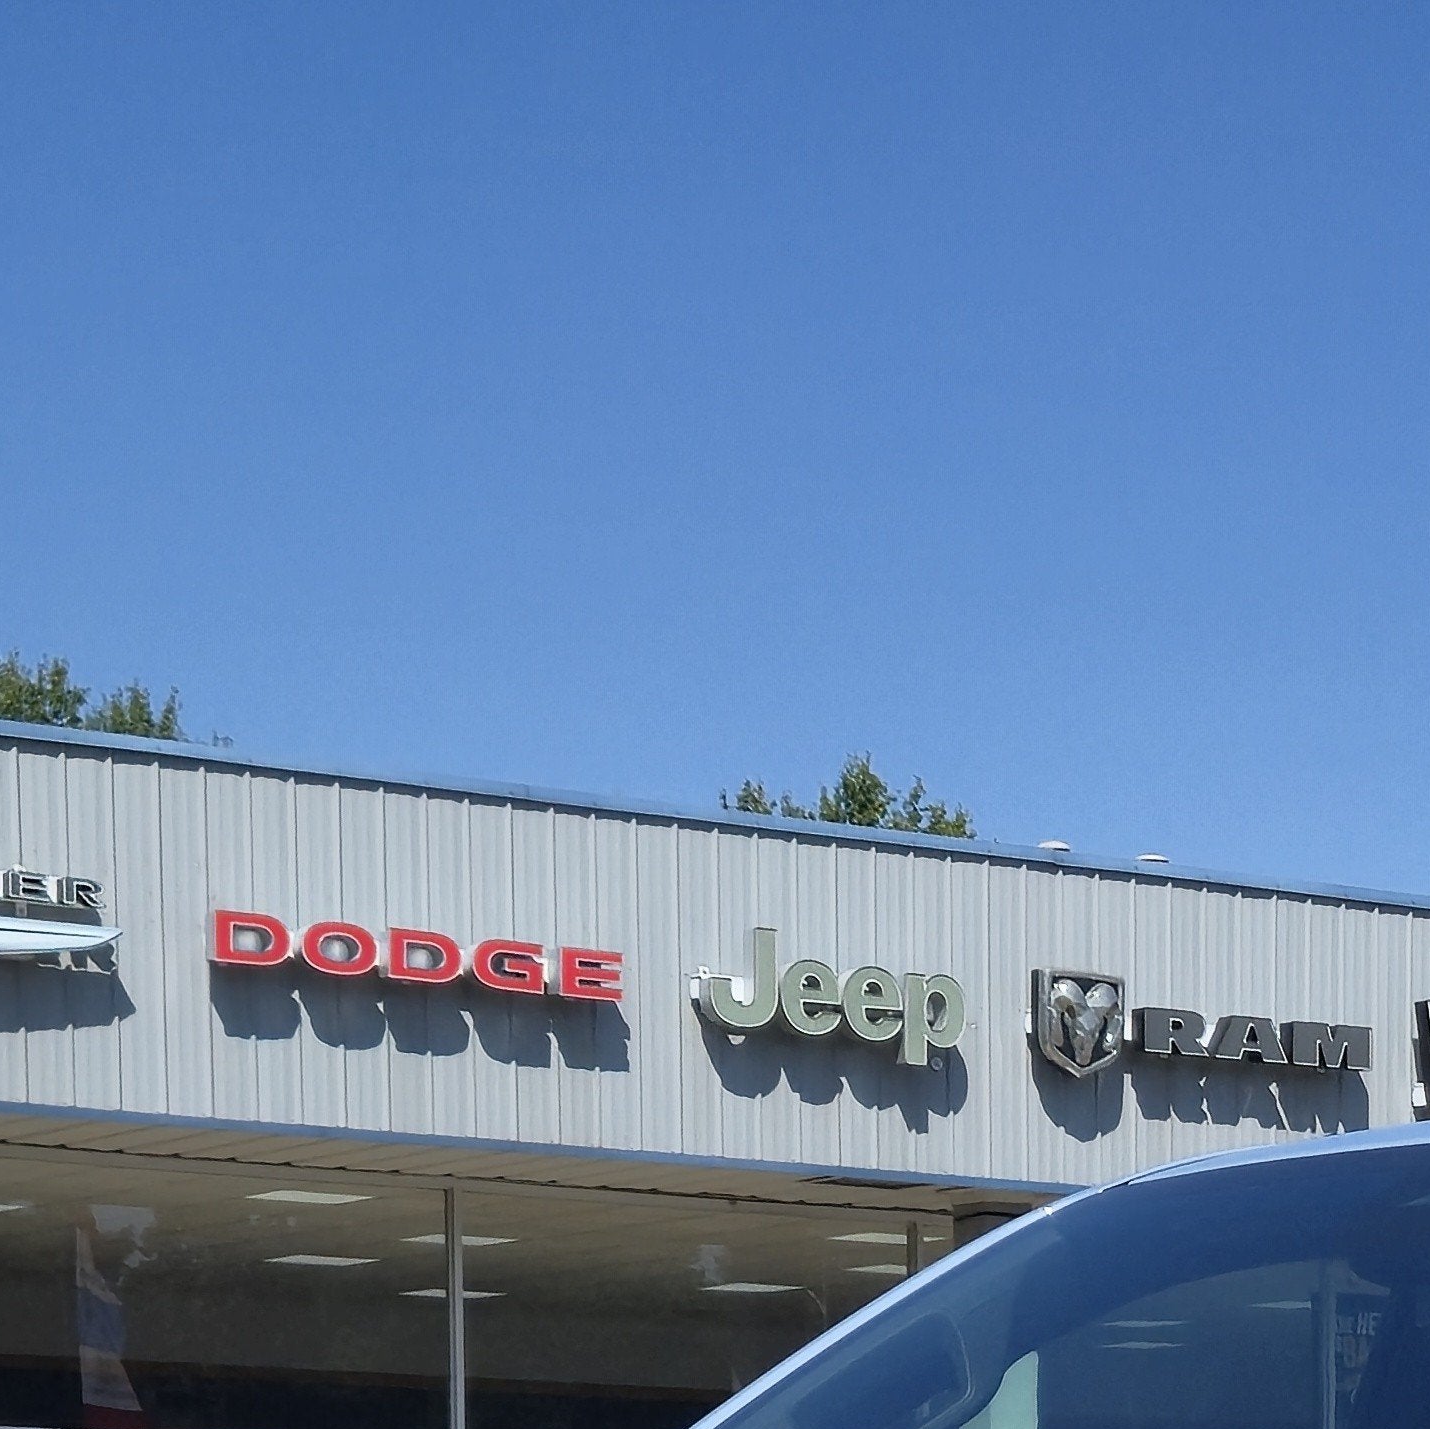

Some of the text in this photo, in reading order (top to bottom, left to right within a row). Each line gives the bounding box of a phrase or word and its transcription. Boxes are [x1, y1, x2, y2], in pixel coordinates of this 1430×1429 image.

[212, 909, 624, 1001] DODGE
[692, 926, 967, 1067] Jeep
[1132, 1006, 1372, 1071] RAM
